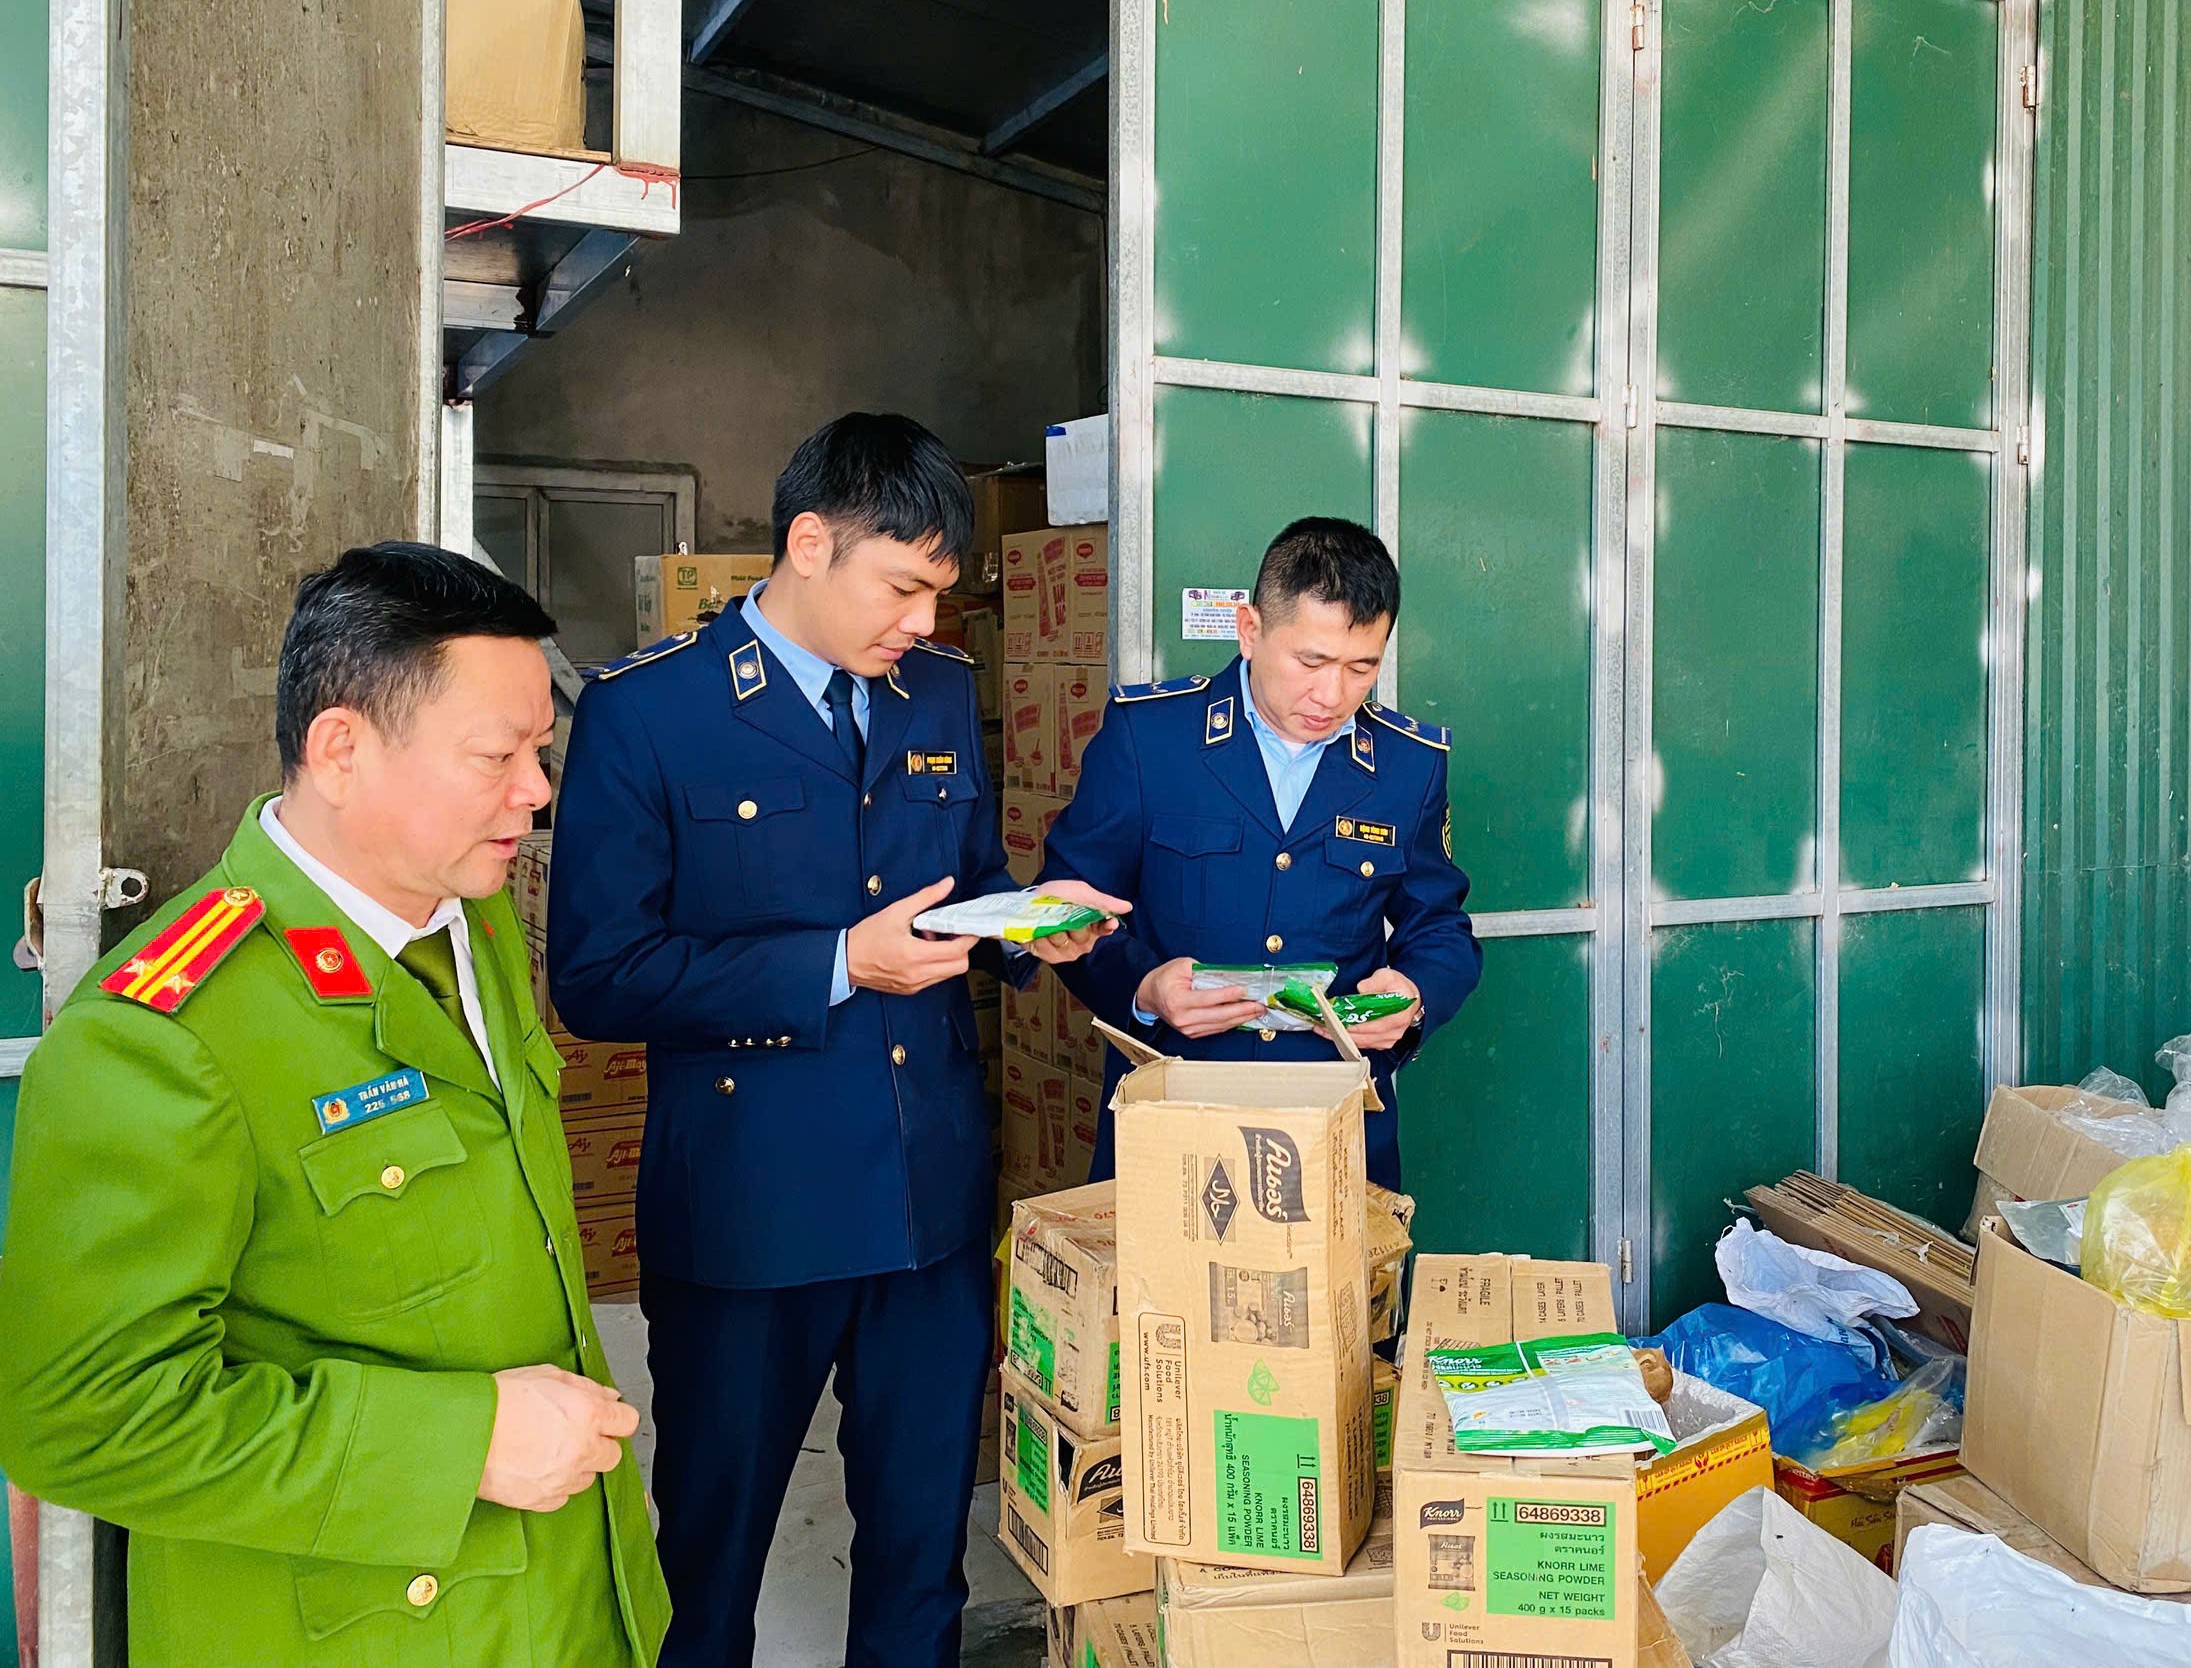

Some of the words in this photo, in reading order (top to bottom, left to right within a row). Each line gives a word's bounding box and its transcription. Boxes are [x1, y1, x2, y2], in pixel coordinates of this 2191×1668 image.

[1479, 1278, 1491, 1306] FRAGILE
[1536, 1282, 1546, 1297] LAYER
[1554, 1278, 1564, 1295] PALLET
[1573, 1280, 1582, 1297] PALLET
[1538, 1301, 1547, 1317] CASES
[1556, 1299, 1566, 1317] LAYERS
[1575, 1301, 1585, 1316] CASES
[1143, 1332, 1152, 1391] www.ufs.com
[1165, 1360, 1173, 1383] Food
[1174, 1360, 1182, 1400] Unilever
[1155, 1359, 1164, 1403] Solutions
[1226, 1463, 1236, 1479] 400
[1242, 1454, 1251, 1505] SEASONING
[1254, 1492, 1264, 1524] KNORR
[1301, 1481, 1315, 1549] 64869338
[1423, 1506, 1462, 1518] Knorr
[1518, 1506, 1601, 1523] 64869338
[1227, 1512, 1237, 1523] 15
[1243, 1508, 1253, 1547] POWDER
[1255, 1527, 1264, 1548] LIME
[1537, 1560, 1576, 1571] KNORR
[1579, 1562, 1605, 1573] LIME
[1492, 1571, 1554, 1584] SEASONING
[1558, 1575, 1605, 1586] POWDER
[1538, 1591, 1560, 1600] NET
[1564, 1592, 1606, 1603] WEIGHT
[1518, 1604, 1536, 1613] 400
[1539, 1606, 1546, 1615] g
[1560, 1605, 1571, 1614] 15
[1575, 1606, 1606, 1616] packs
[1449, 1623, 1480, 1631] Unilever
[1449, 1637, 1484, 1645] Solutions
